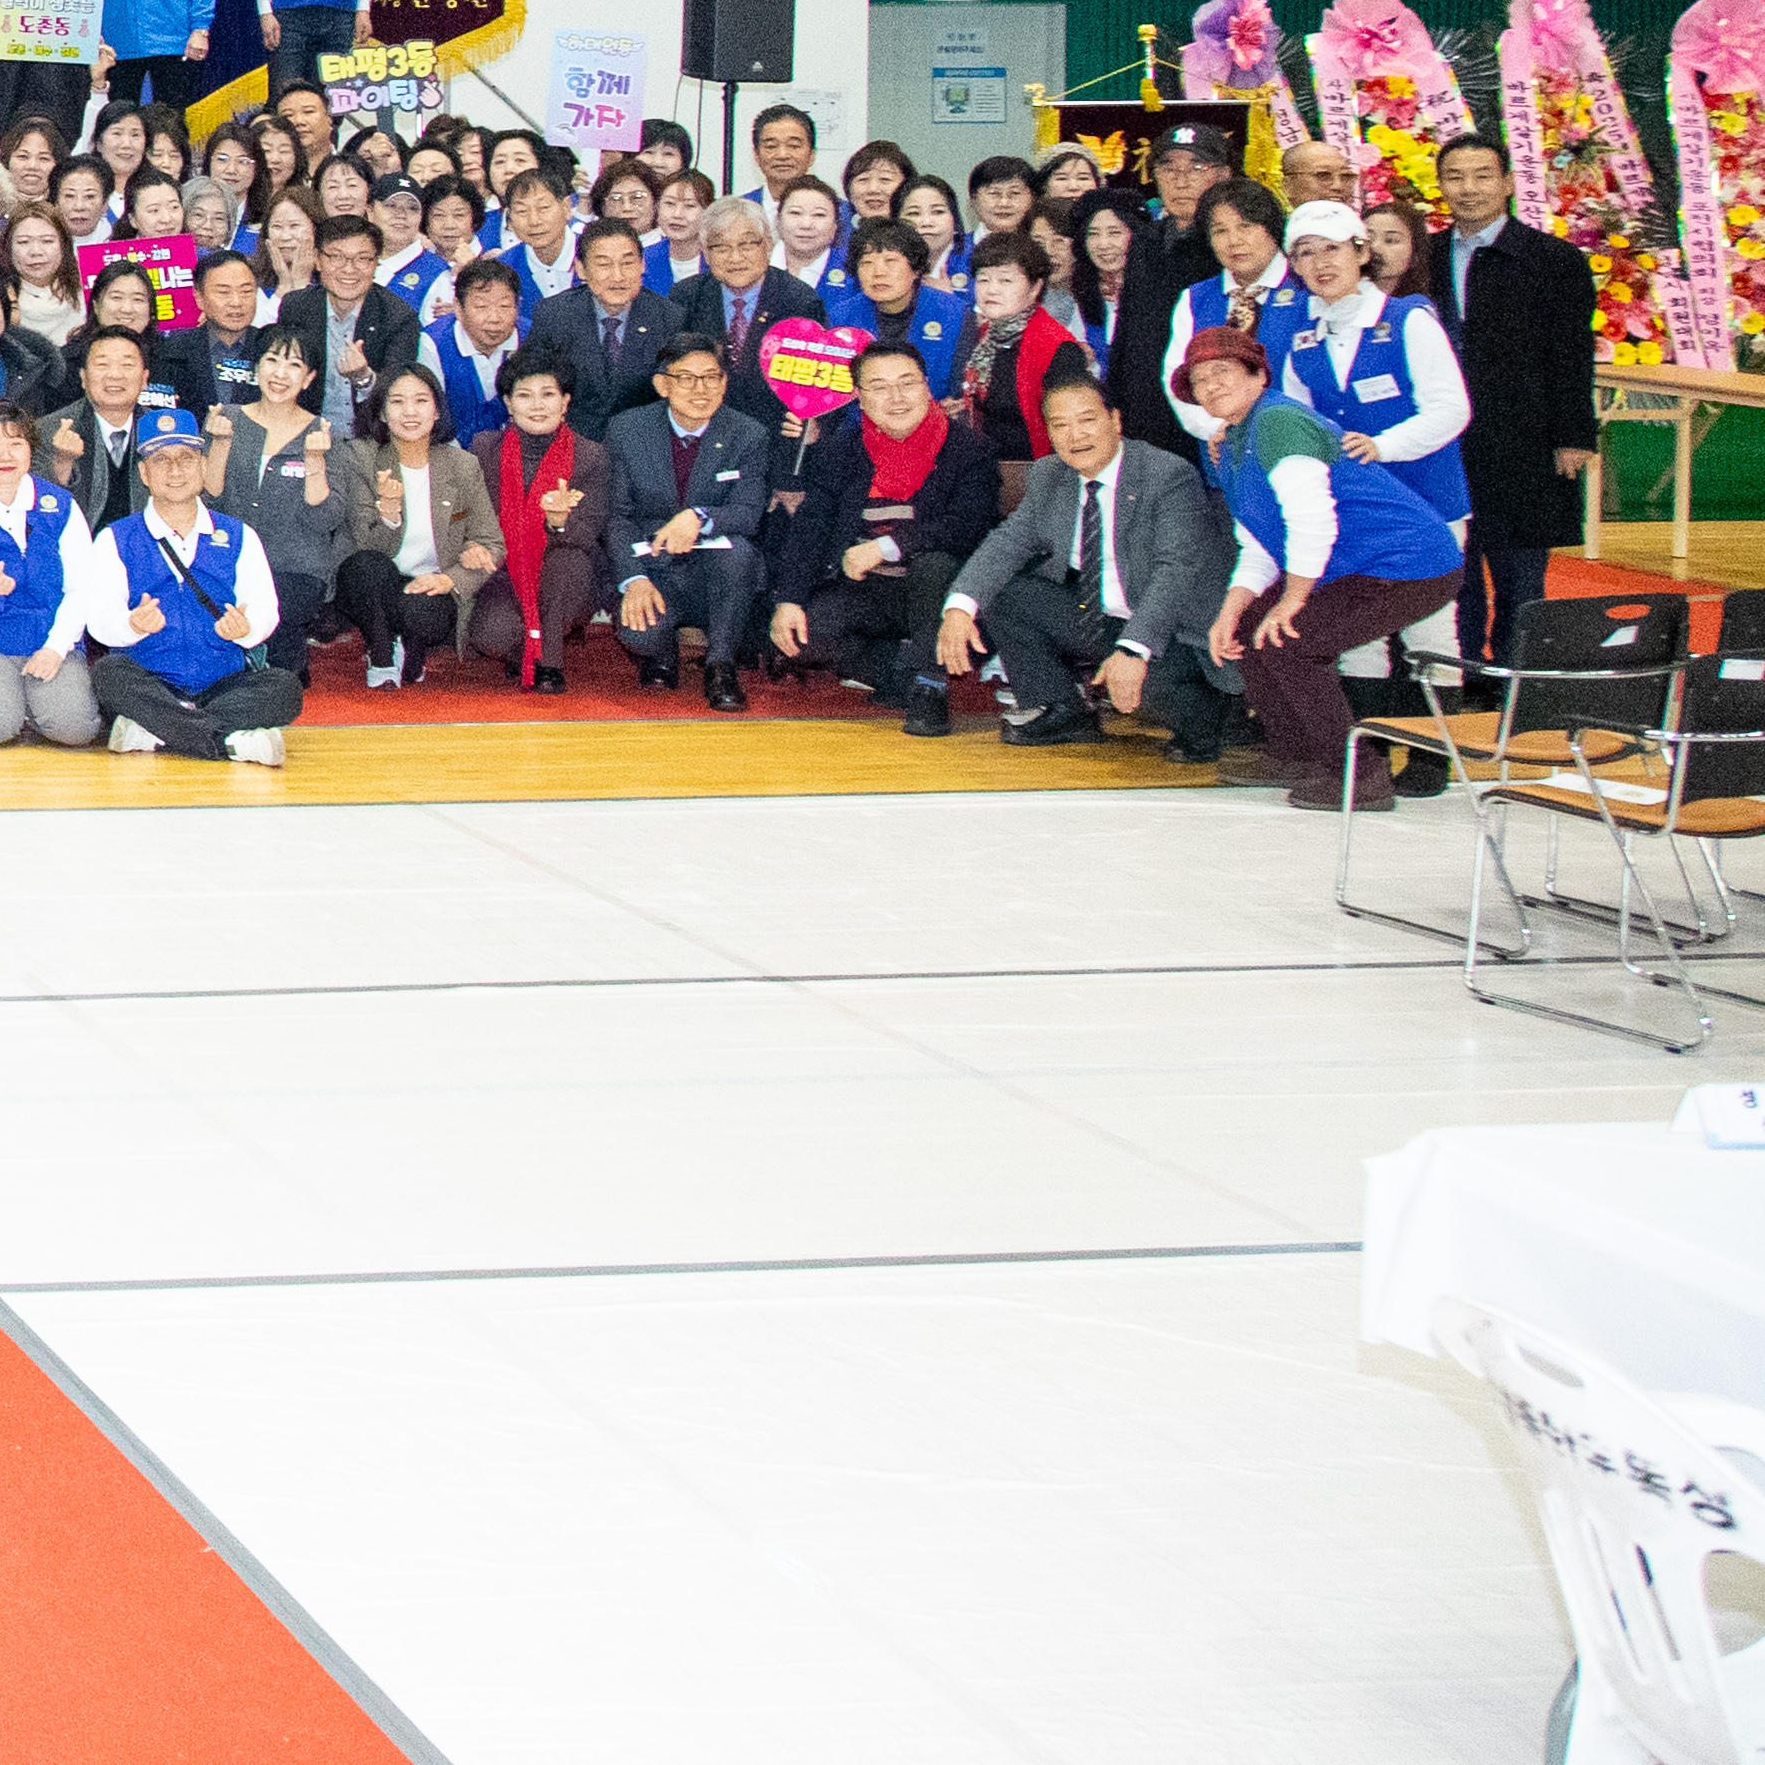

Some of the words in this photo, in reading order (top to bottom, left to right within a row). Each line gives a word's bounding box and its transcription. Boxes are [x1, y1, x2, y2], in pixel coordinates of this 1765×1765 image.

[18, 15, 71, 37] 도촌동
[321, 40, 437, 82] 태평3동
[329, 79, 420, 113] 파이팅
[564, 67, 630, 98] 함께
[769, 353, 854, 393] 태평3동
